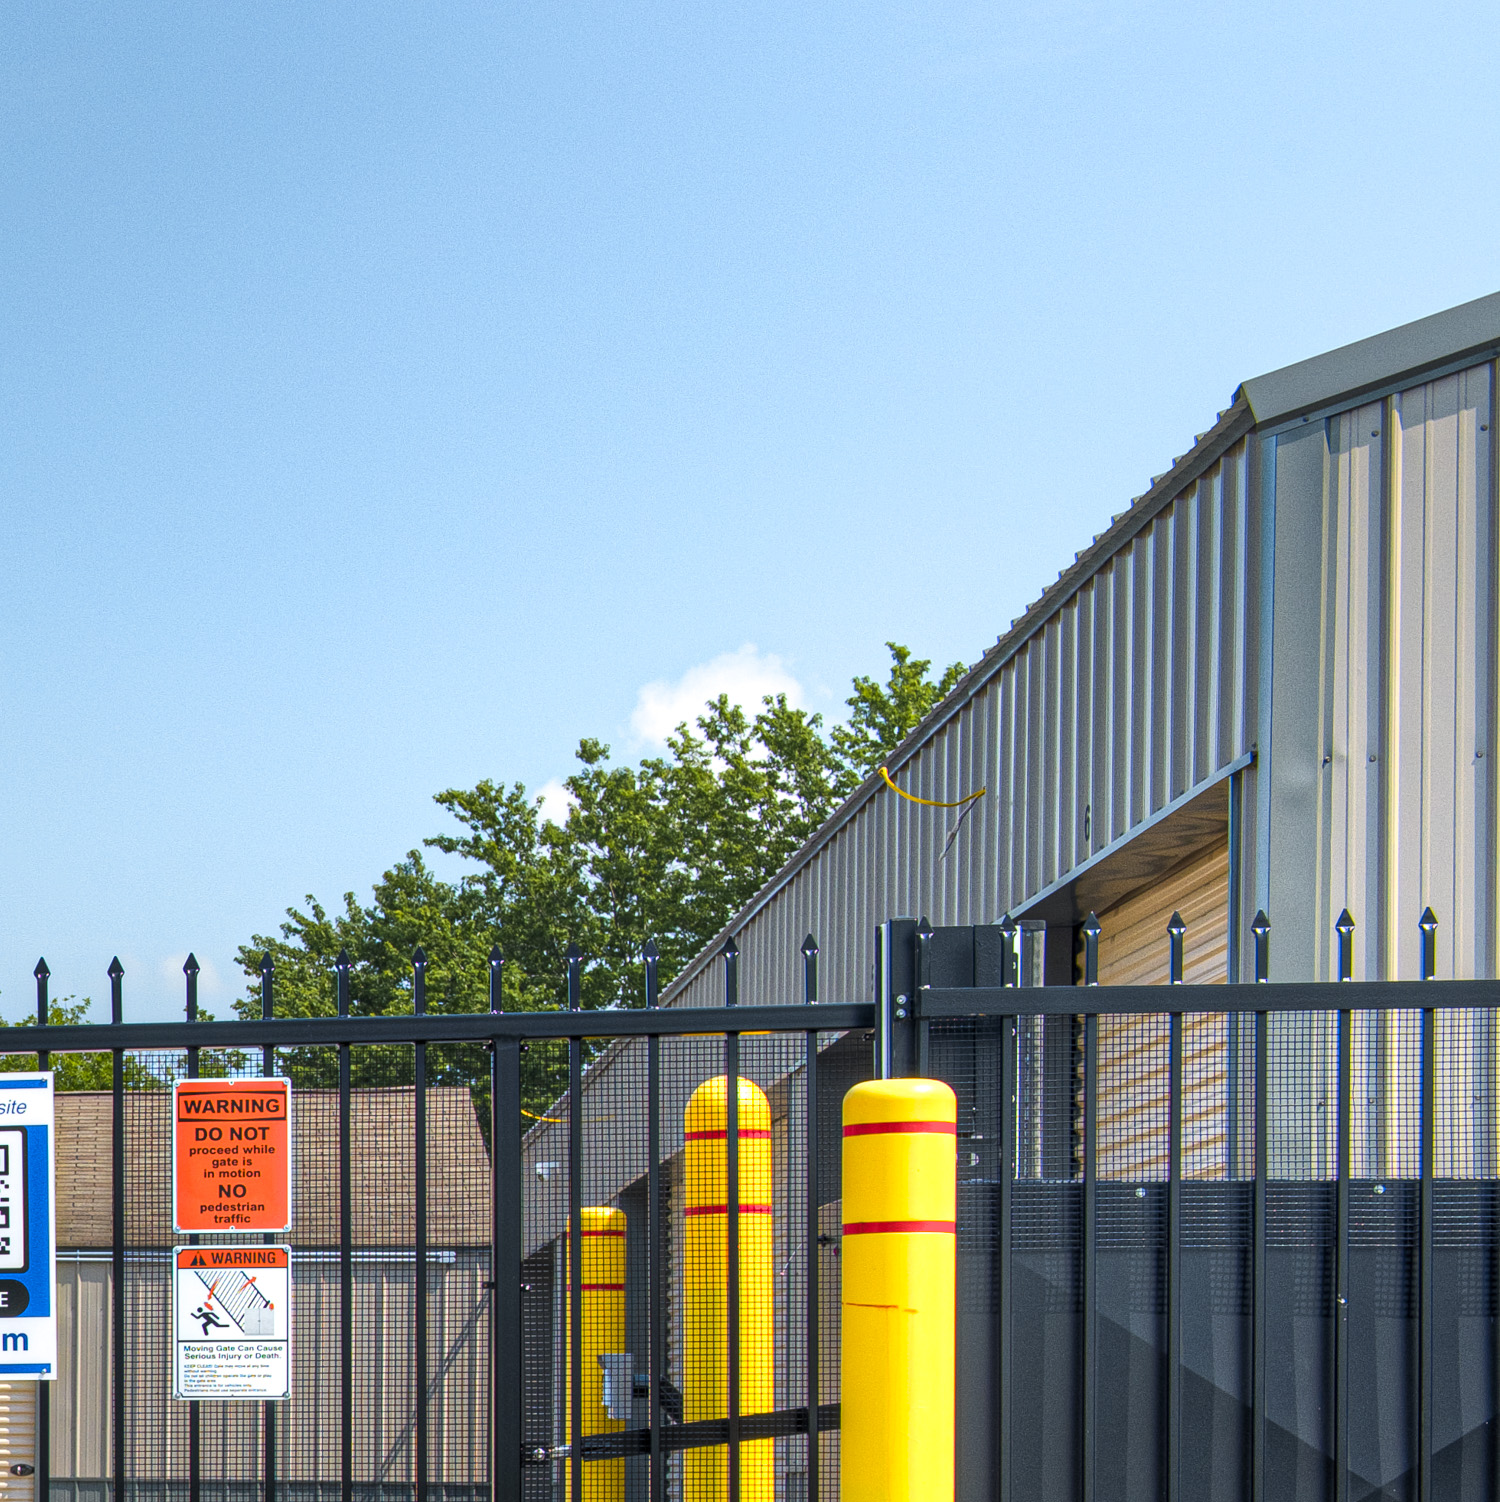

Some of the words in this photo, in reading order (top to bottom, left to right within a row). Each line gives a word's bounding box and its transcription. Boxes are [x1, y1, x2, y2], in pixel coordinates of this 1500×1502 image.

[1085, 804, 1091, 842] 6
[184, 1099, 280, 1114] WARNING
[195, 1127, 223, 1142] DO
[230, 1126, 270, 1141] NOT
[189, 1145, 239, 1156] proceed
[243, 1145, 276, 1154] while
[212, 1158, 239, 1169] gate
[242, 1157, 253, 1166] is
[204, 1168, 215, 1178] in
[218, 1168, 261, 1178] motion
[218, 1184, 247, 1198] NO
[200, 1202, 265, 1214] pedestrian
[214, 1214, 251, 1224] traffic
[211, 1251, 276, 1265] WARNING
[183, 1345, 214, 1353] Moving
